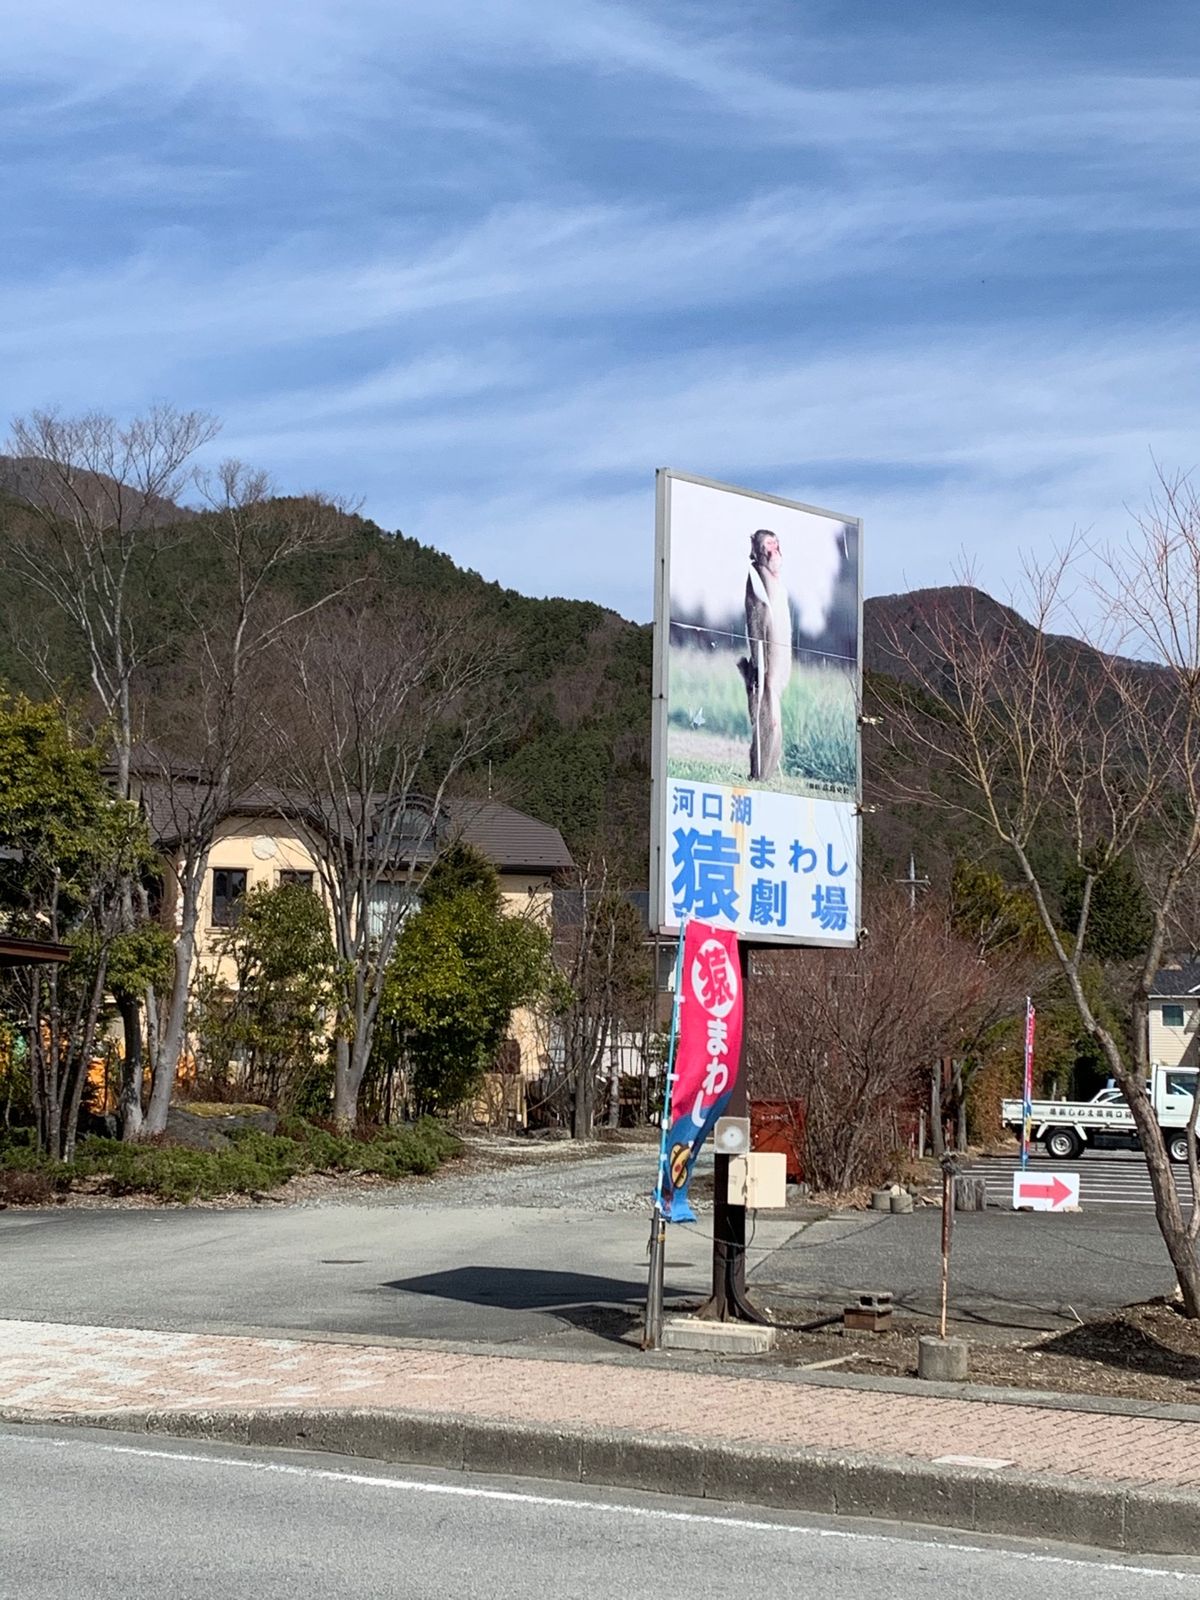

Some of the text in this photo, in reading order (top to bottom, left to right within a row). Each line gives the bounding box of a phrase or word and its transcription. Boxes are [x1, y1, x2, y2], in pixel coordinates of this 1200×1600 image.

[672, 786, 751, 826] 河口湖
[749, 878, 848, 931] 劇場
